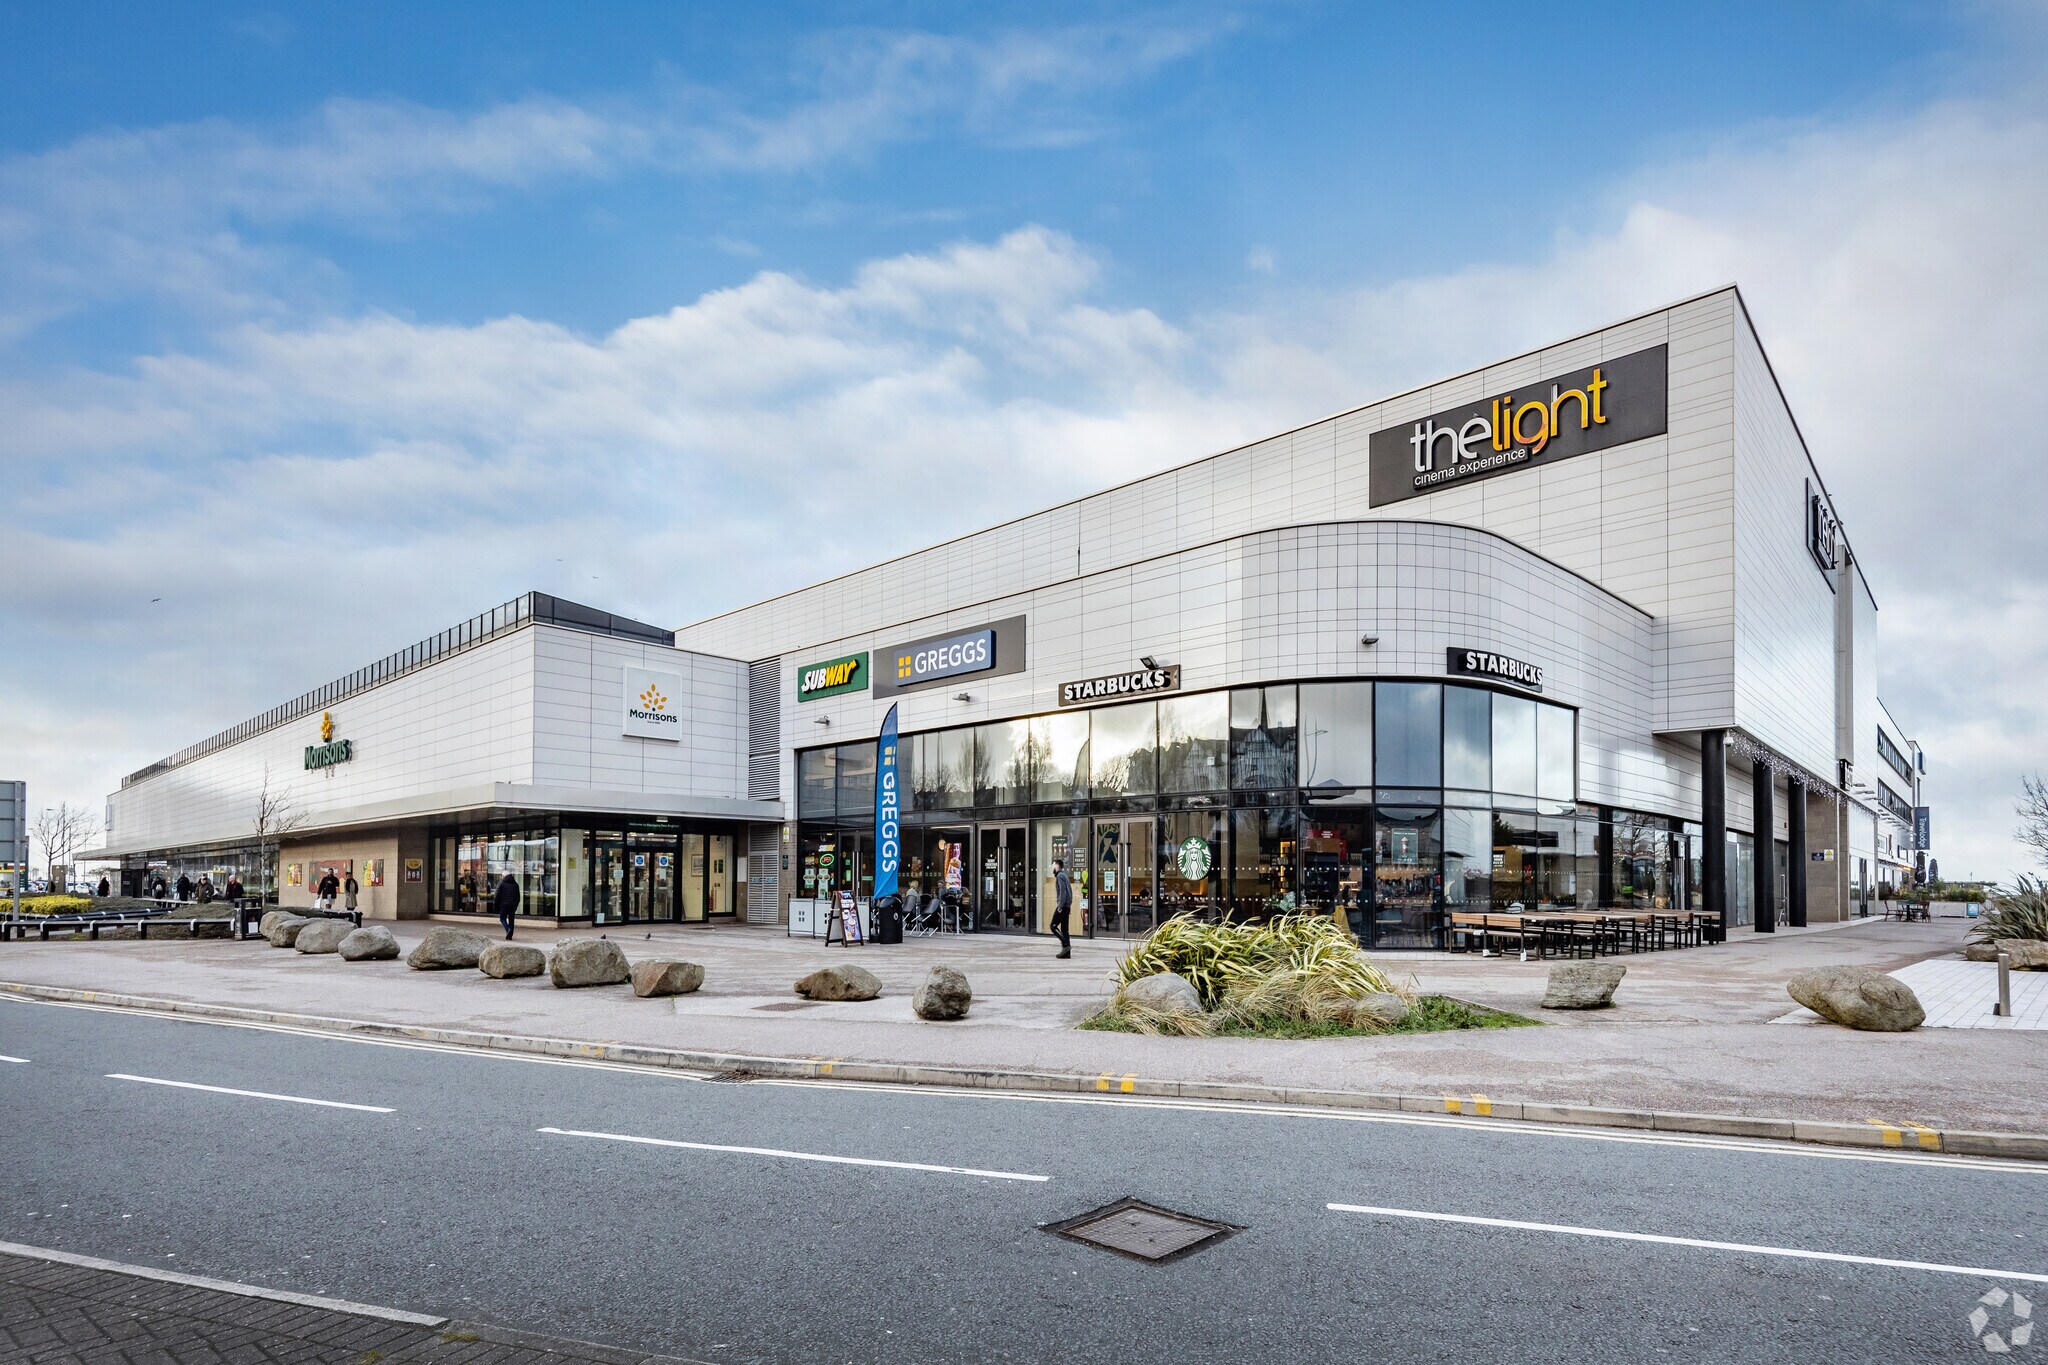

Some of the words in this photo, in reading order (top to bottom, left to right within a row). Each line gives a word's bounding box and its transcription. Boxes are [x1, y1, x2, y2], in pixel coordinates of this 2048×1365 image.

[1414, 467, 1456, 487] cinema
[1459, 448, 1526, 475] experience
[914, 639, 986, 674] GREGGS
[1466, 651, 1543, 685] STARBUCKS
[801, 659, 857, 692] SUBWAY
[1064, 670, 1165, 700] STARBUCKS
[629, 708, 678, 723] Morrisons
[304, 739, 350, 770] Morrisons
[881, 771, 898, 873] GREGGS
[1918, 817, 1927, 848] Travelodge
